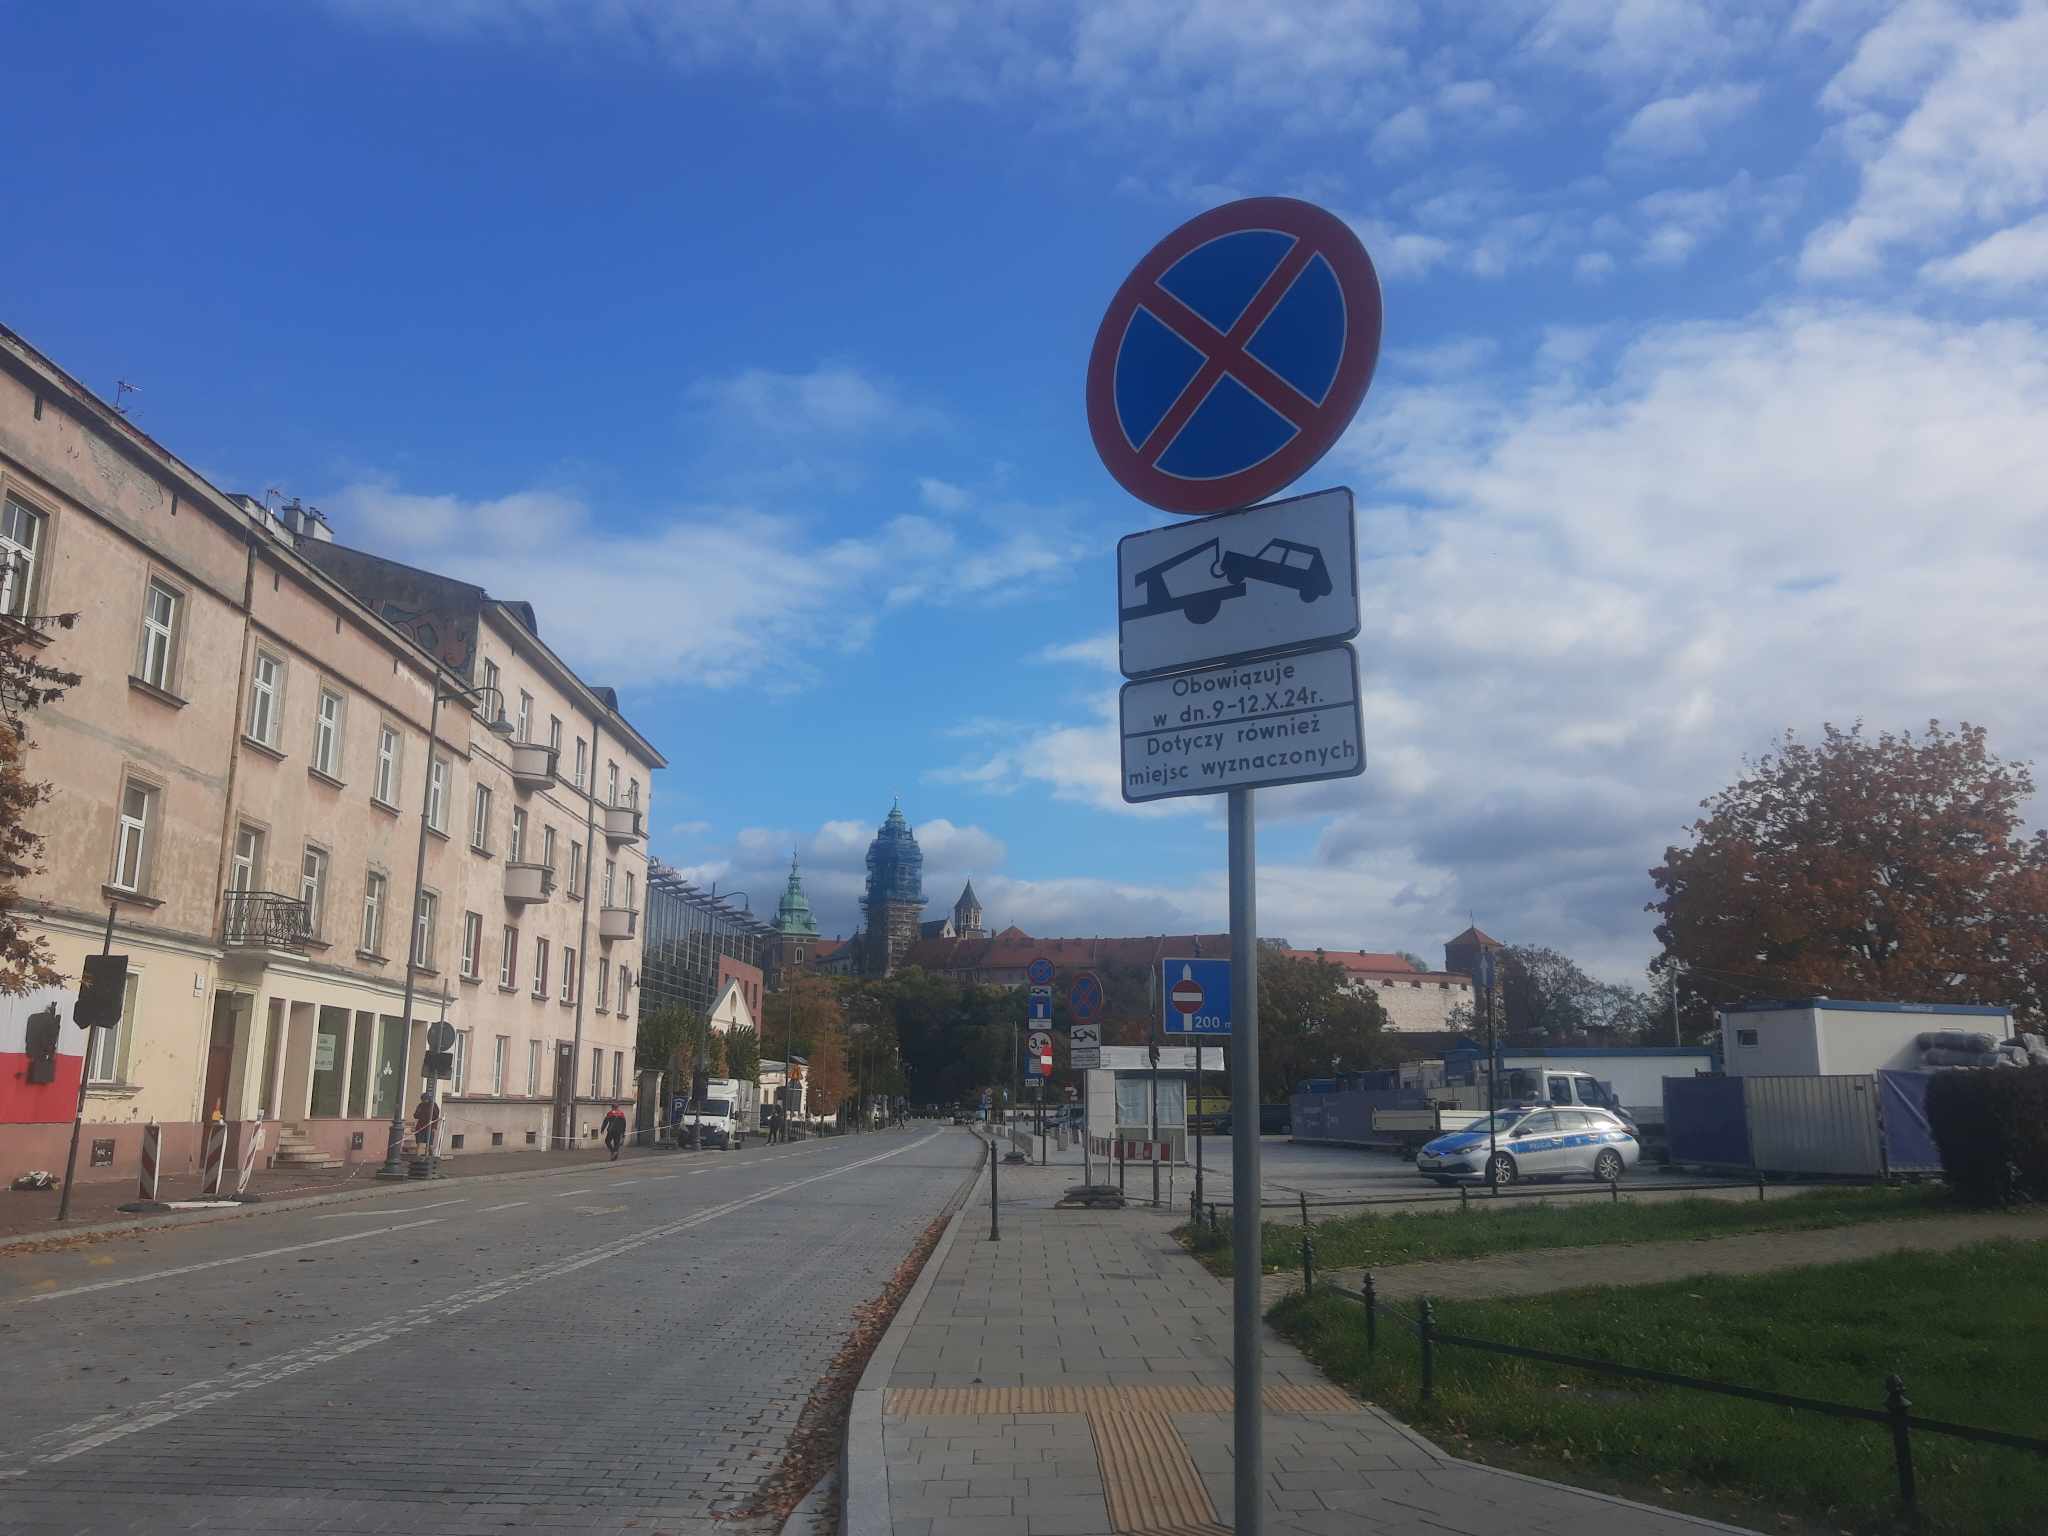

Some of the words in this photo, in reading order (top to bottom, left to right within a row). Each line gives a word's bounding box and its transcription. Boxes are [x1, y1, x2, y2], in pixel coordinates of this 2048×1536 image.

[1172, 662, 1295, 697] Obowiązuje
[1147, 731, 1224, 756] Dotyczy
[1237, 714, 1320, 743] również
[1153, 712, 1167, 728] w
[1128, 768, 1189, 786] miejsc
[1201, 739, 1354, 779] wyznaczonych
[1194, 1015, 1220, 1029] 200
